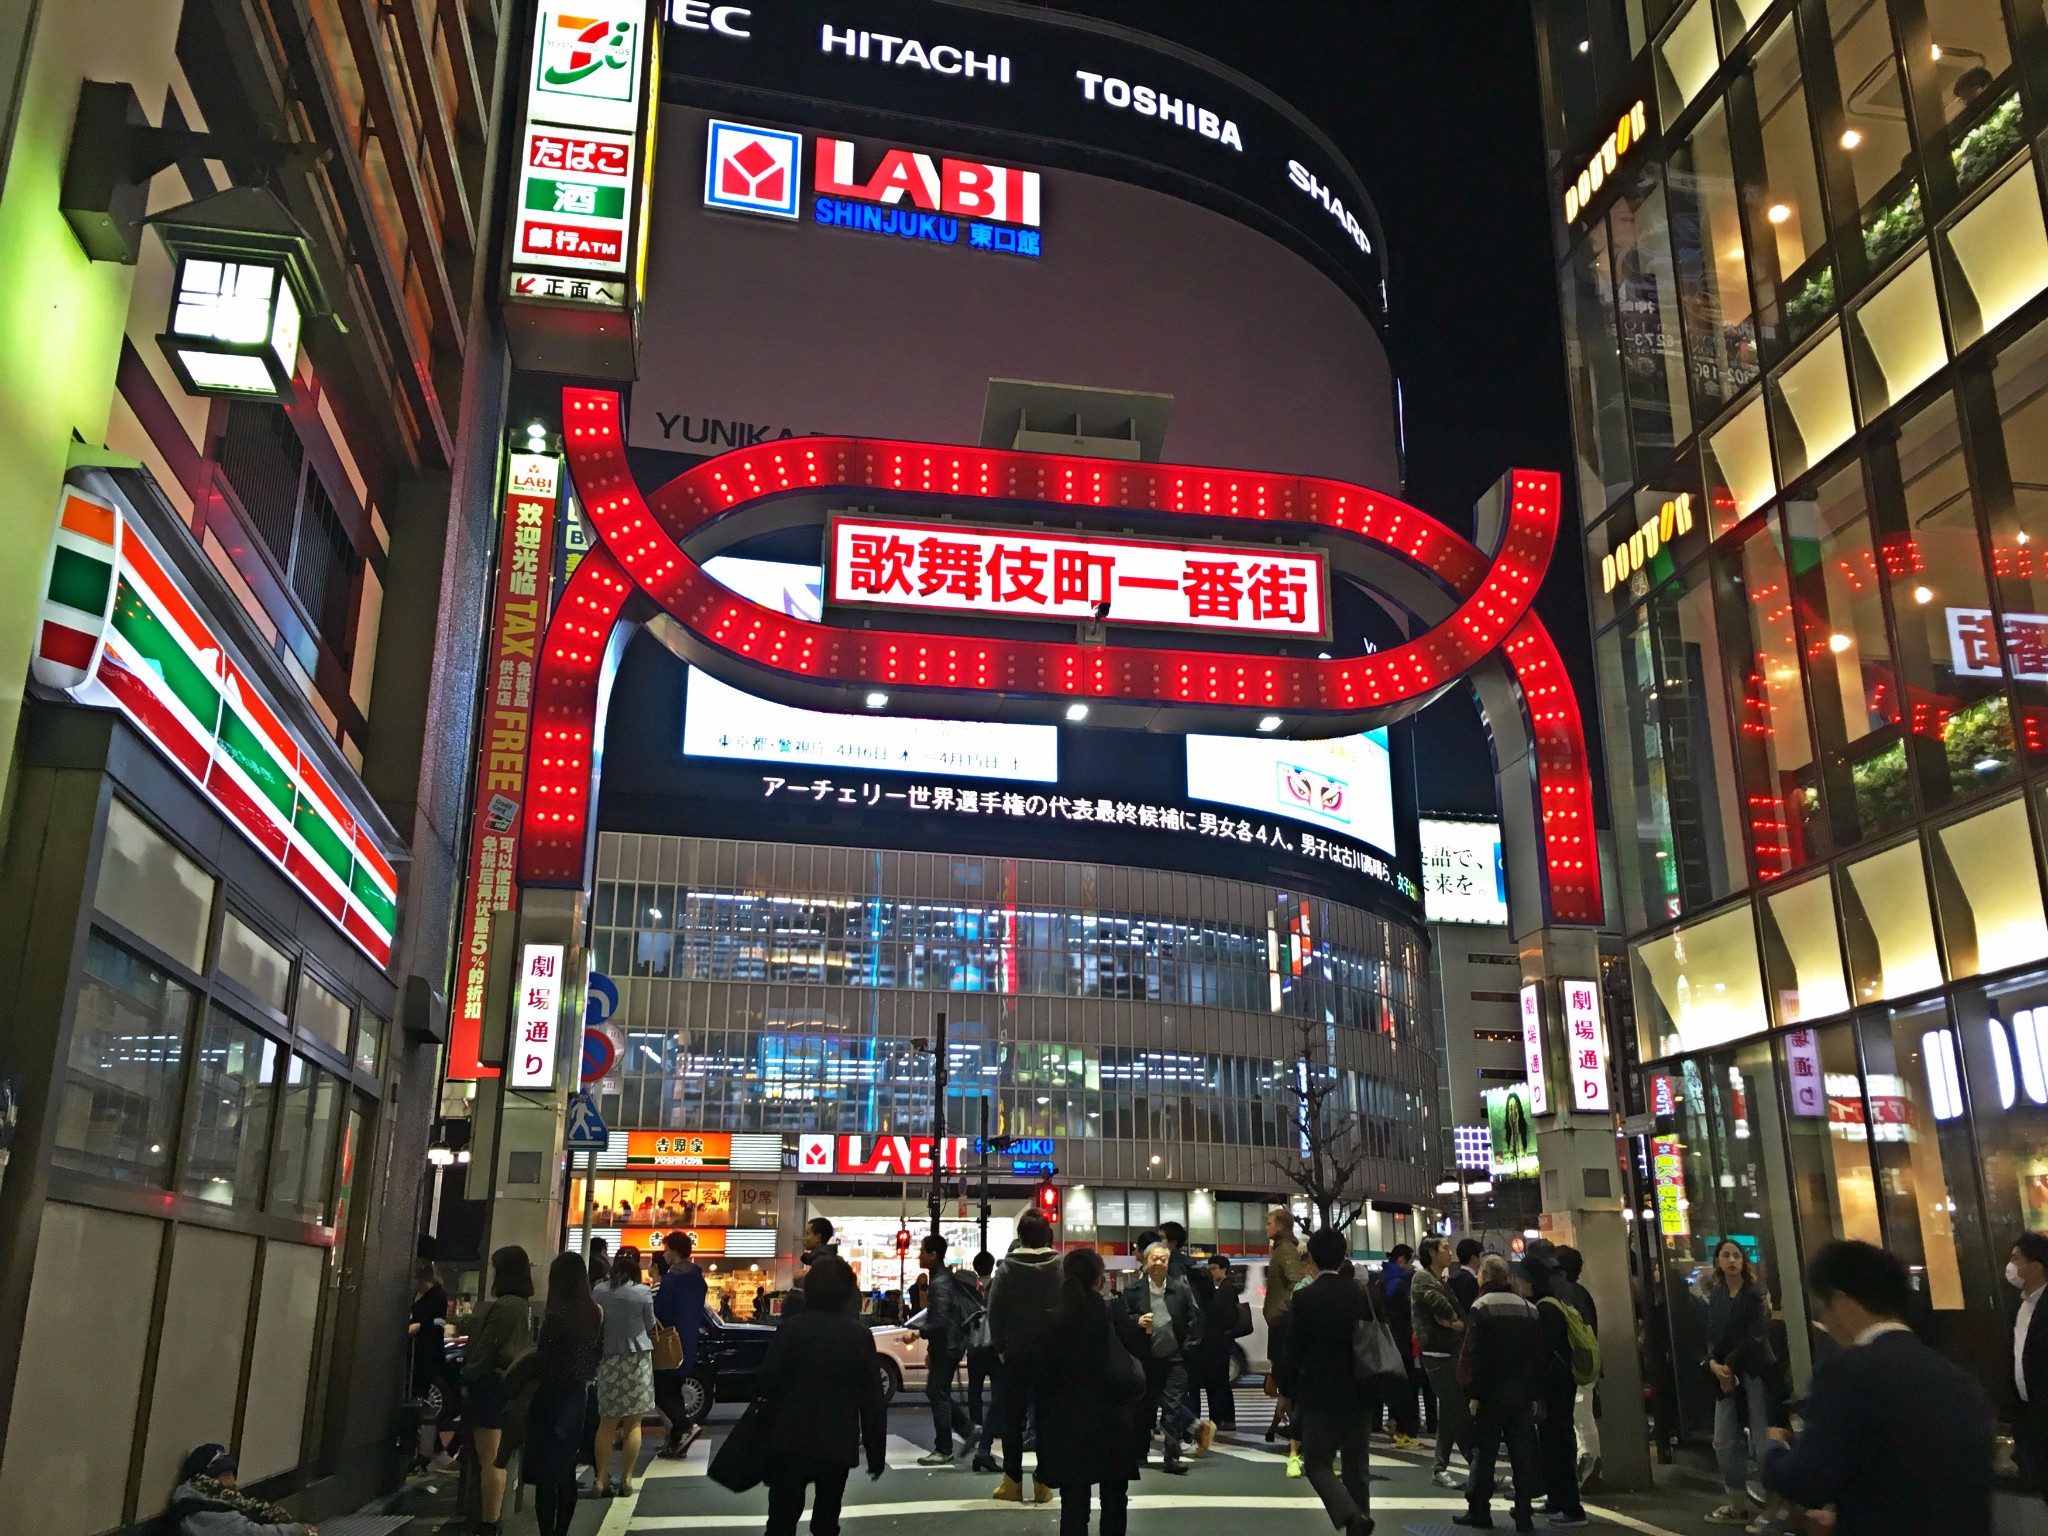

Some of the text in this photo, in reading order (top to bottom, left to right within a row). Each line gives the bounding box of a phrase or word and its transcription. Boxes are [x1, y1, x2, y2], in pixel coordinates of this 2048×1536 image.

[664, 0, 751, 37] EC
[822, 25, 1010, 83] HITACHI
[1076, 70, 1243, 151] TOSHIBA
[533, 138, 625, 174] たばこ
[814, 136, 1040, 227] LABI
[1565, 100, 1646, 225] DOUTOR
[553, 182, 598, 214] 酒
[815, 197, 1041, 258] SHINJUKU 東口館
[1288, 159, 1371, 254] SHARP
[544, 278, 614, 300] 正面へ
[514, 475, 552, 488] LABI
[510, 502, 543, 596] 欢迎光临
[1602, 492, 1693, 594] DOUTOR
[851, 534, 1307, 623] 歌舞伎町一番街
[501, 600, 537, 658] TAX
[488, 711, 527, 791] FREE
[525, 955, 554, 1075] 劇場通り
[1525, 995, 1542, 1103] 劇場通り
[1572, 990, 1599, 1100] 劇場通り
[656, 1137, 704, 1154] 吉野家
[838, 1135, 967, 1174] LABI
[670, 1188, 690, 1204] 2F
